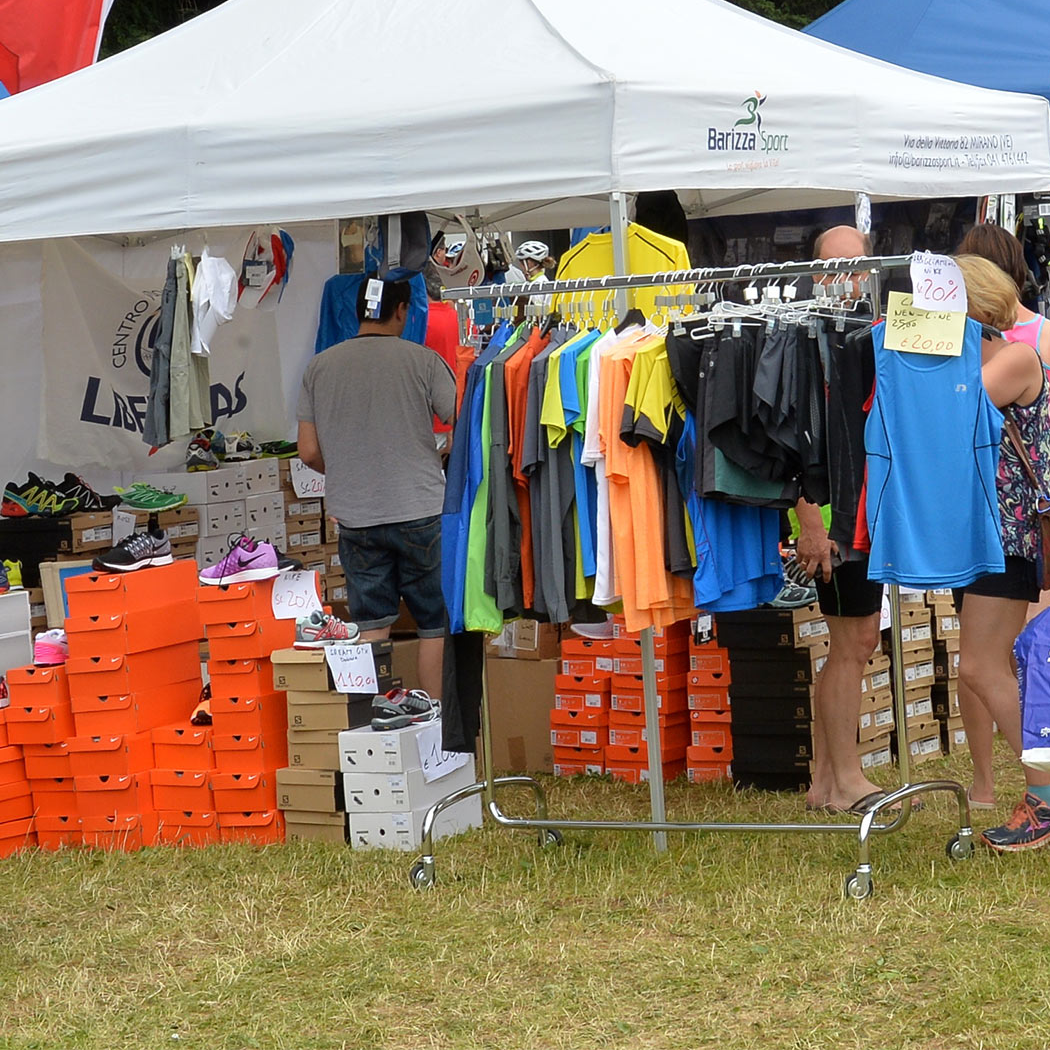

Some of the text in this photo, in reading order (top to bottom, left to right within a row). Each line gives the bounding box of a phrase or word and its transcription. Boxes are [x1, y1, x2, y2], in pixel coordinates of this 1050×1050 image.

[708, 127, 789, 155] Barizza Sport
[924, 278, 958, 301] 20%
[112, 299, 149, 369] CENTRO
[80, 371, 248, 434] LIBEAS
[287, 590, 315, 609] 20%
